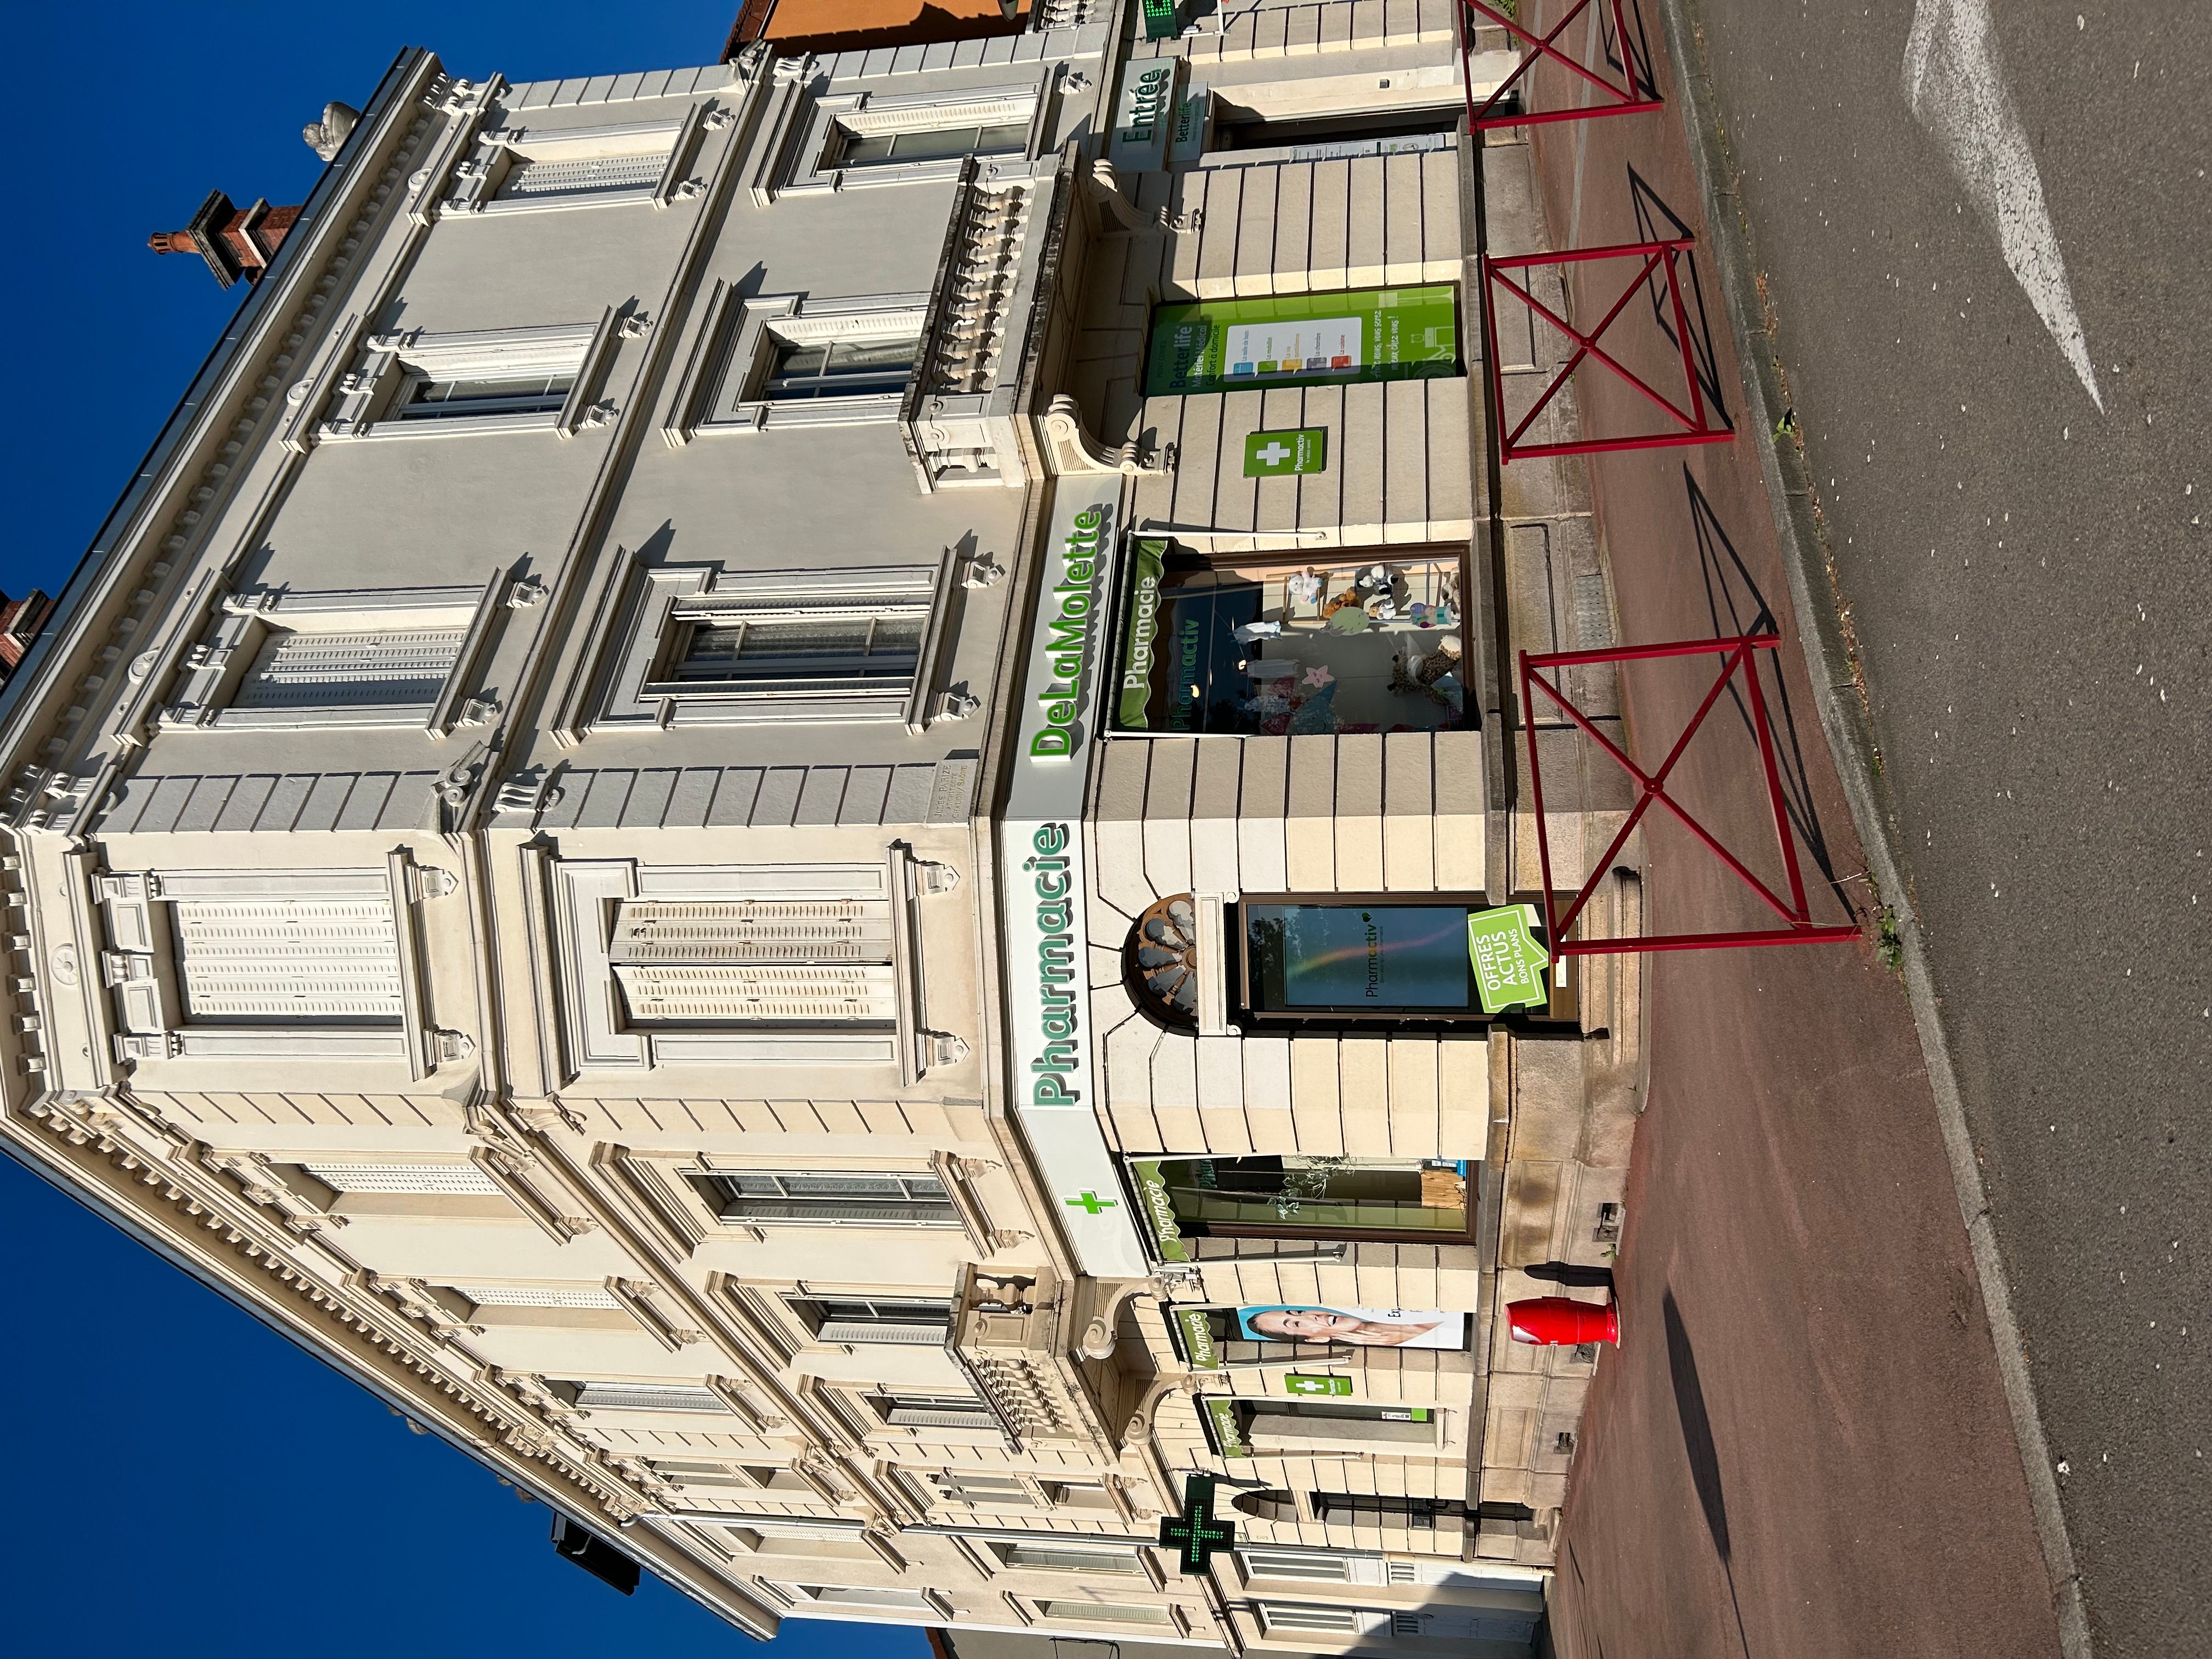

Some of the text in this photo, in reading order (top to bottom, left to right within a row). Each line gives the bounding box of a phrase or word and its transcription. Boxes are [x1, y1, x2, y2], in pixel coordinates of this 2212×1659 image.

[1122, 69, 1162, 143] Entrée
[1175, 103, 1192, 143] Betterlife
[1169, 326, 1192, 388] Betterlife
[1191, 325, 1207, 387] Matériel Médical
[1209, 325, 1220, 352] domicile
[1206, 360, 1217, 386] Confort
[1294, 434, 1305, 471] Pharmactiv
[1029, 511, 1102, 762] DeLaMolette
[1124, 576, 1155, 689] Pharmacie
[1170, 619, 1199, 730] Pharmactiv
[1022, 825, 1079, 1107] Pharmacie
[1365, 924, 1378, 997] Pharmactiv
[1476, 934, 1501, 991] OFFRES
[1491, 931, 1518, 985] ACTUS
[1508, 928, 1530, 984] BONS PLANS
[1143, 1180, 1177, 1243] Pharmacie
[1185, 1313, 1212, 1361] Pharmacie
[1215, 1413, 1238, 1448] Pharmacie
